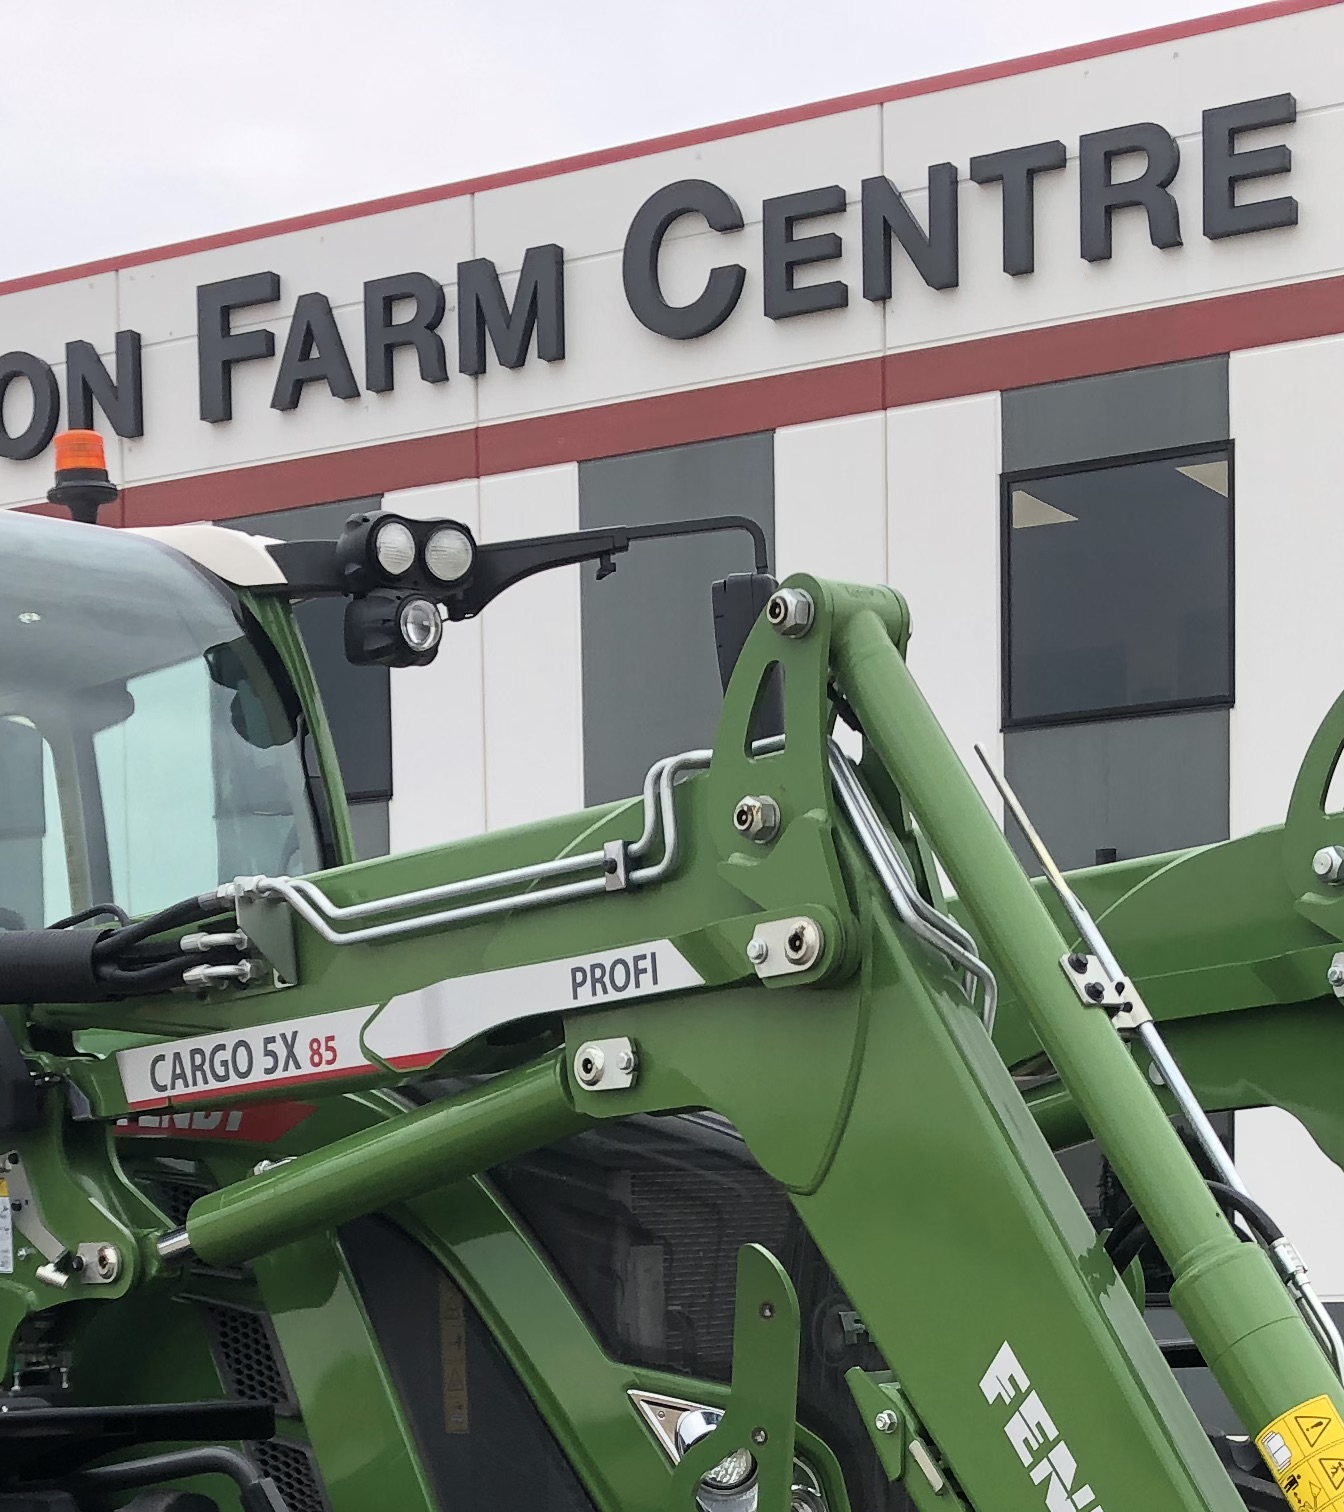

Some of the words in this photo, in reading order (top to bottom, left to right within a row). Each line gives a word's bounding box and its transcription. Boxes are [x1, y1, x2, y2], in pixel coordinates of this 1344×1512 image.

[197, 243, 566, 424] FARM
[622, 92, 1299, 341] CENTRE
[570, 951, 659, 1000] PROFI
[149, 1039, 254, 1093] CARGO
[262, 1030, 303, 1075] 5X
[308, 1035, 338, 1068] 85
